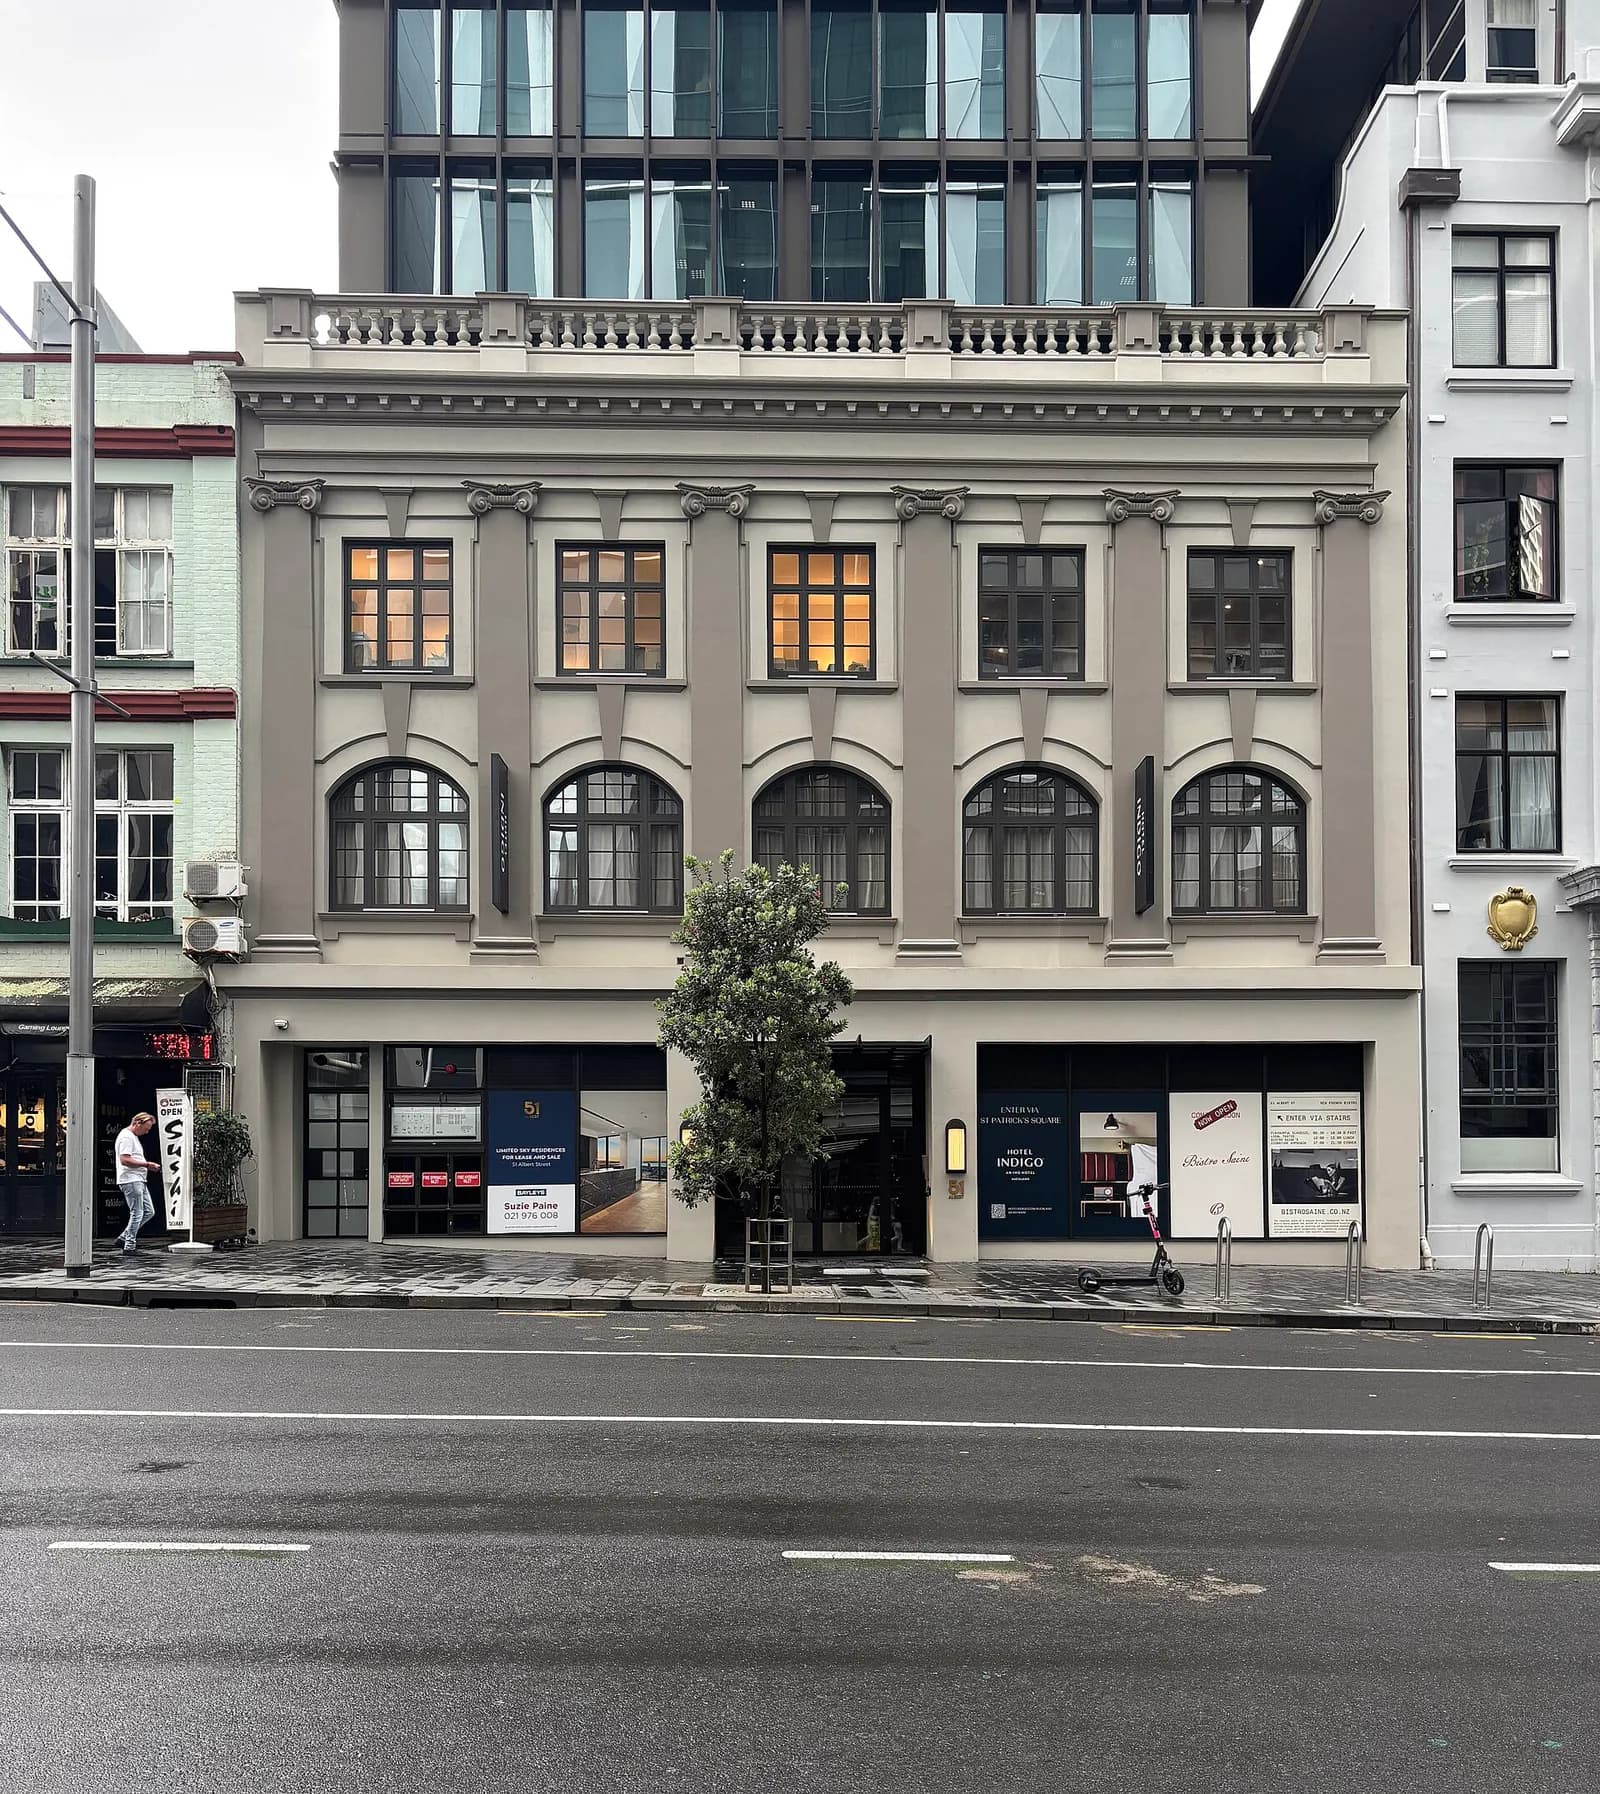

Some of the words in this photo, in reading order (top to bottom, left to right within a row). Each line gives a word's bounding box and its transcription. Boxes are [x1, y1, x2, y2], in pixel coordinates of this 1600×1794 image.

[160, 1108, 183, 1116] OPEN
[524, 1101, 540, 1115] 51
[1001, 1106, 1025, 1114] ENTER
[1026, 1106, 1040, 1114] VIA
[991, 1116, 1030, 1124] PATRICK'S
[1031, 1116, 1061, 1124] SQUARE
[1197, 1115, 1213, 1127] NOW
[1214, 1102, 1235, 1118] OPEN
[997, 1157, 1044, 1168] INDIGO
[1182, 1154, 1218, 1167] Bistro
[164, 1119, 183, 1217] Sushi
[948, 1179, 965, 1196] 51
[504, 1202, 530, 1210] Suzie
[532, 1201, 559, 1210] Paine
[504, 1212, 519, 1220] 021
[521, 1212, 538, 1220] 976
[540, 1211, 559, 1219] 008
